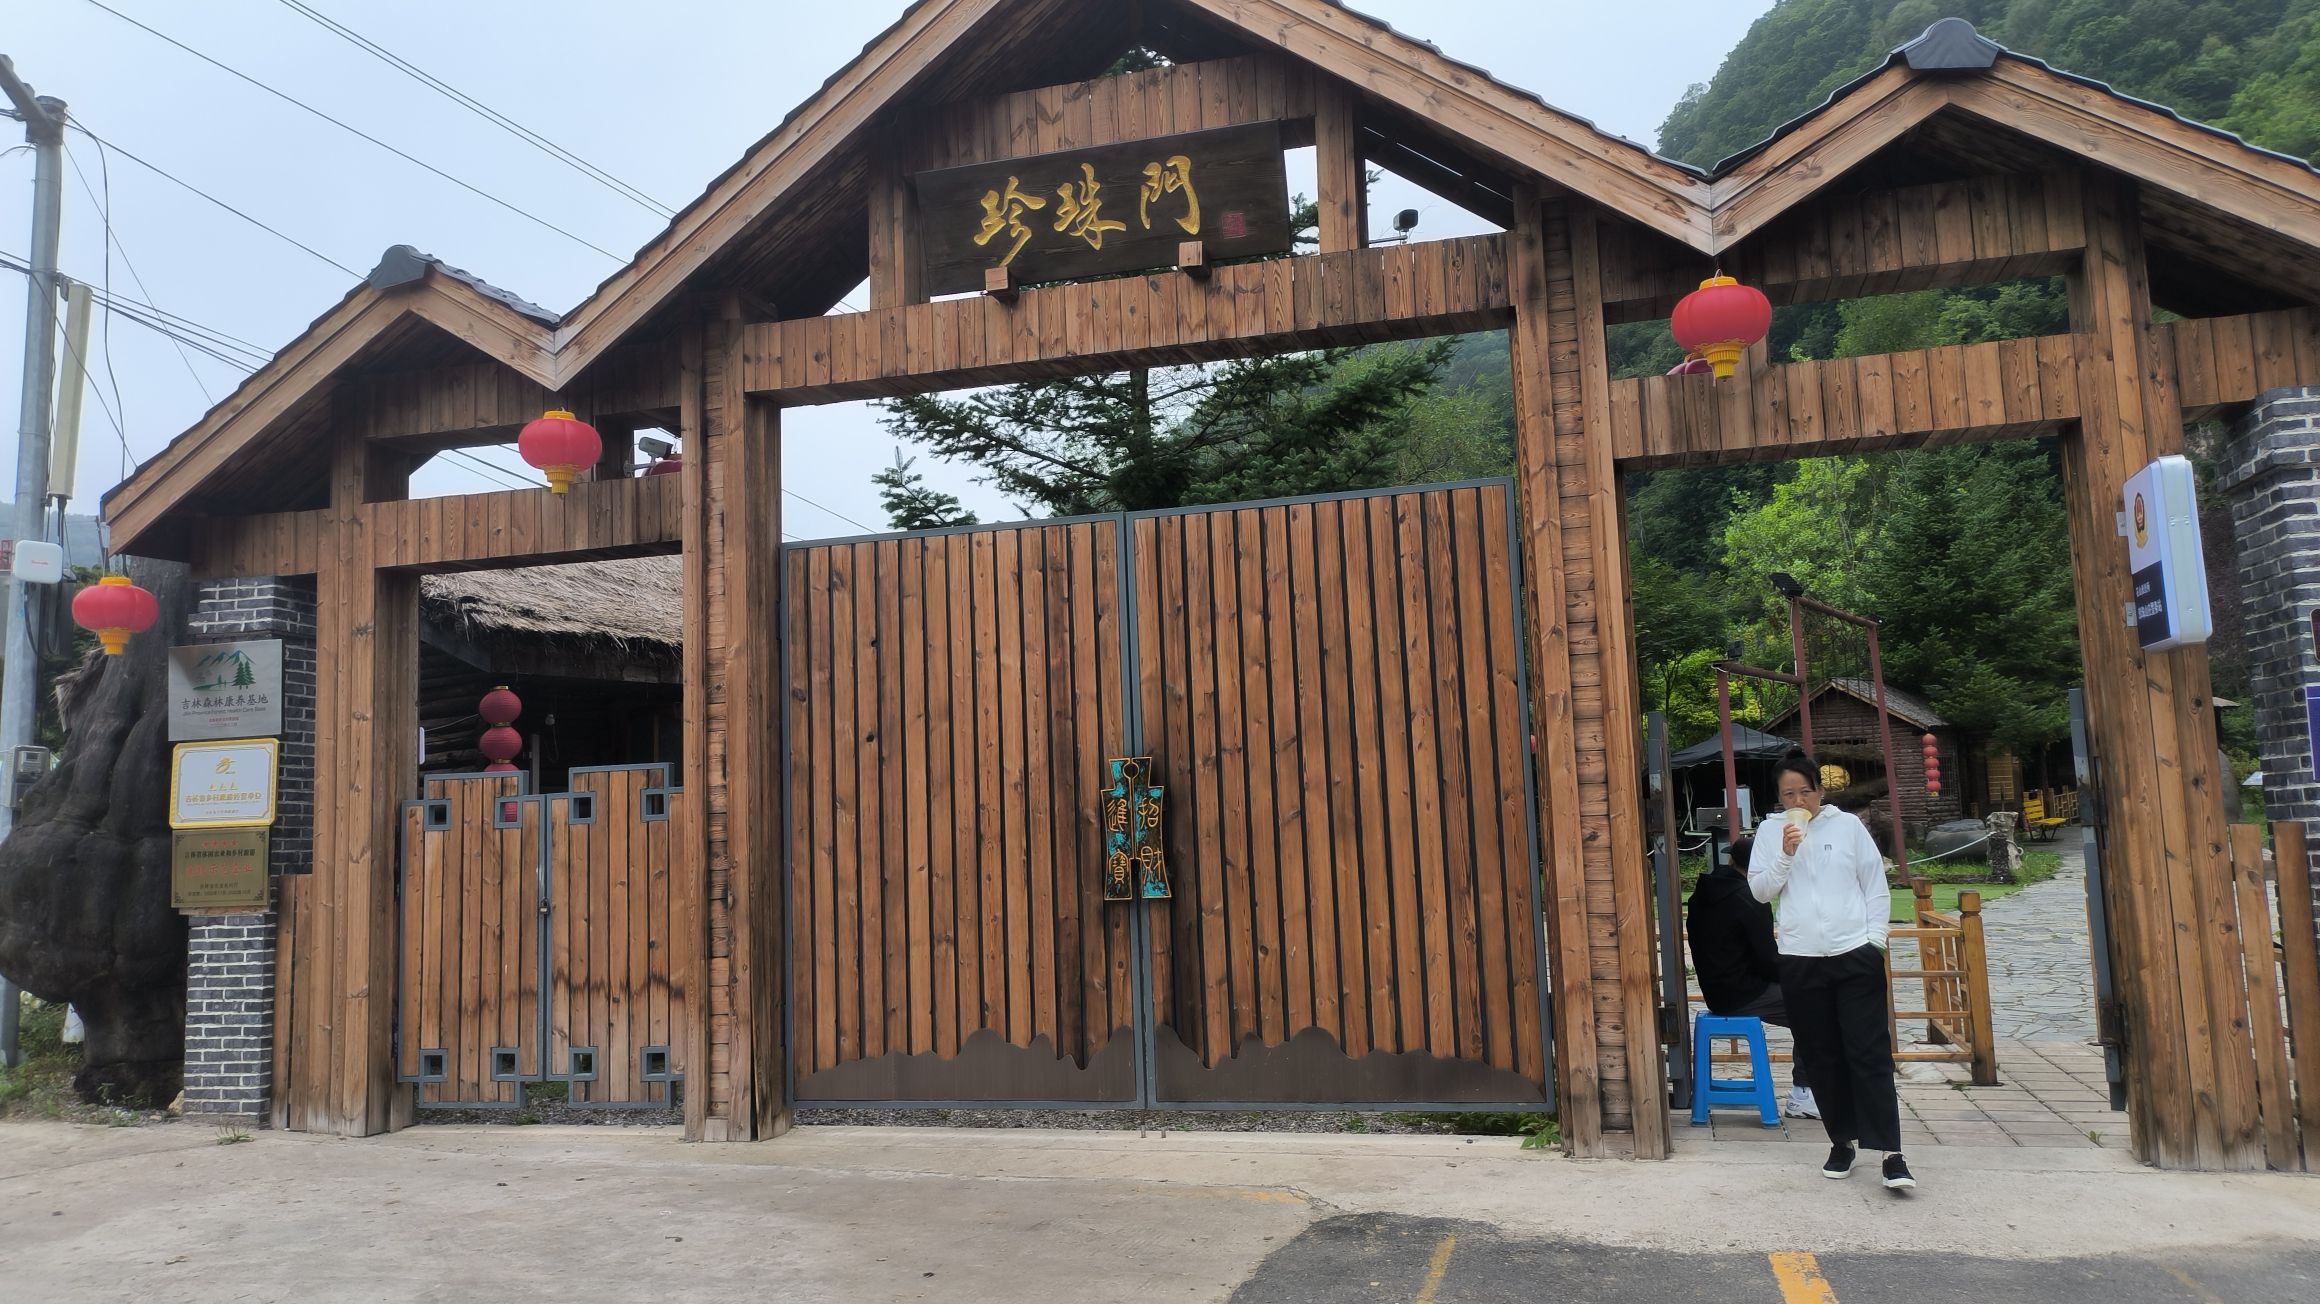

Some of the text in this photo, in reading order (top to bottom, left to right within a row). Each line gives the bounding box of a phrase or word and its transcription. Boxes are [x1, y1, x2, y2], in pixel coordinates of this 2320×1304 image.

[973, 155, 1200, 267] 珍珠門
[181, 693, 269, 710] 吉林森林康养基地
